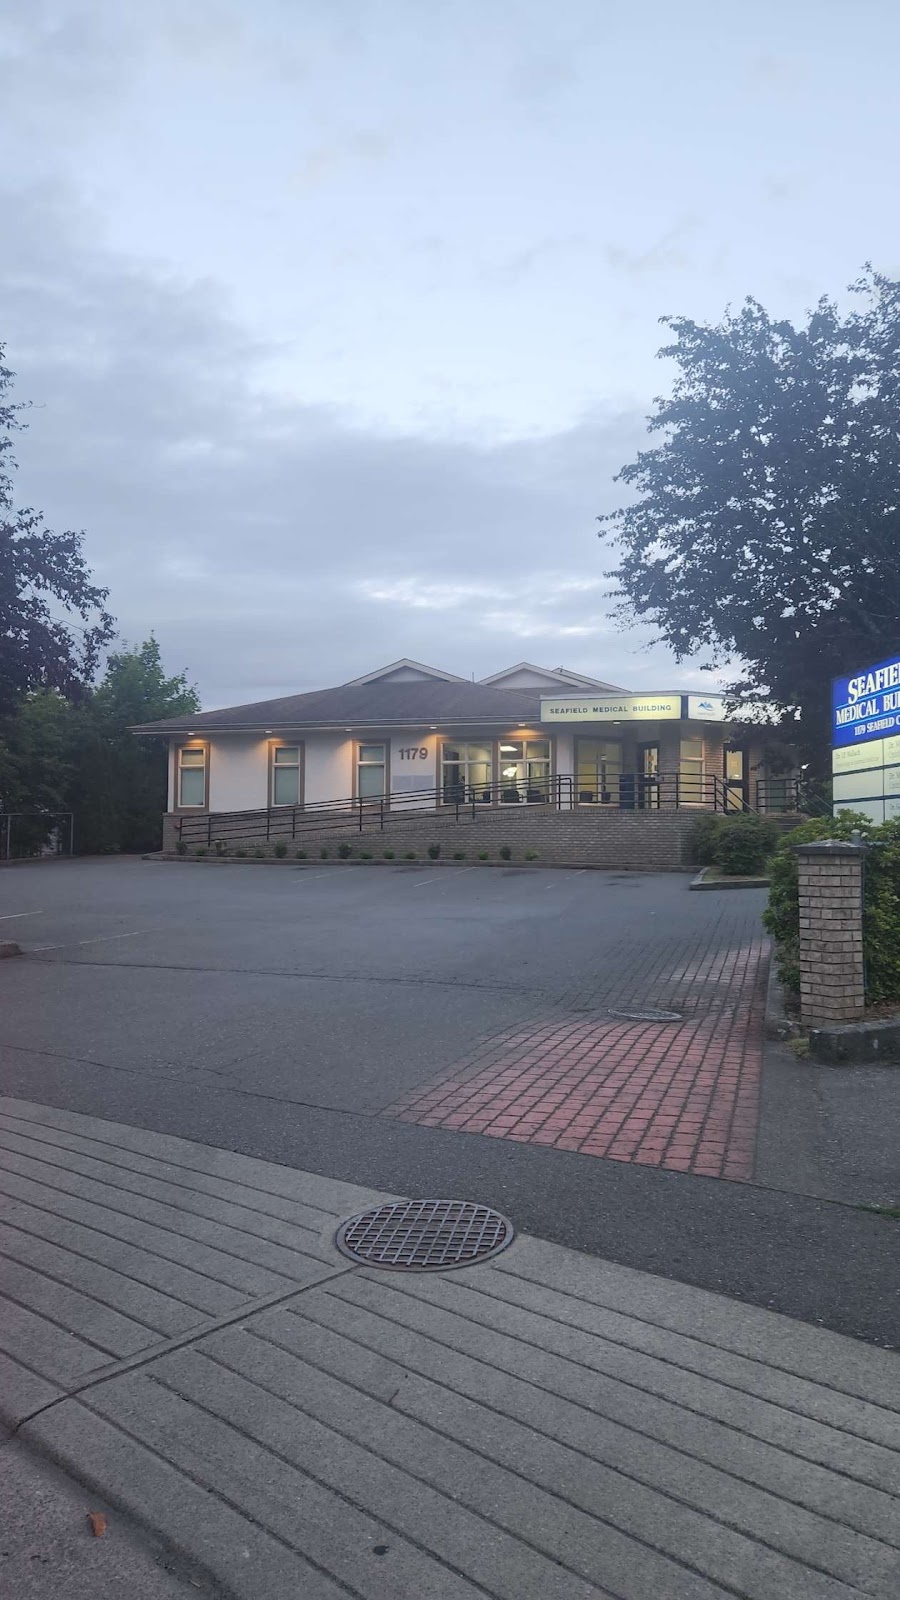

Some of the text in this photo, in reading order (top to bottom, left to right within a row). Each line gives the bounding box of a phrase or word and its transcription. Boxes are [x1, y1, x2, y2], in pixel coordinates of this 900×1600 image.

[549, 707, 588, 715] SEAFIELD
[632, 704, 672, 712] BUILDING
[835, 699, 879, 725] MEDICAL
[866, 716, 895, 733] SEAFIELD
[398, 747, 428, 760] 1179
